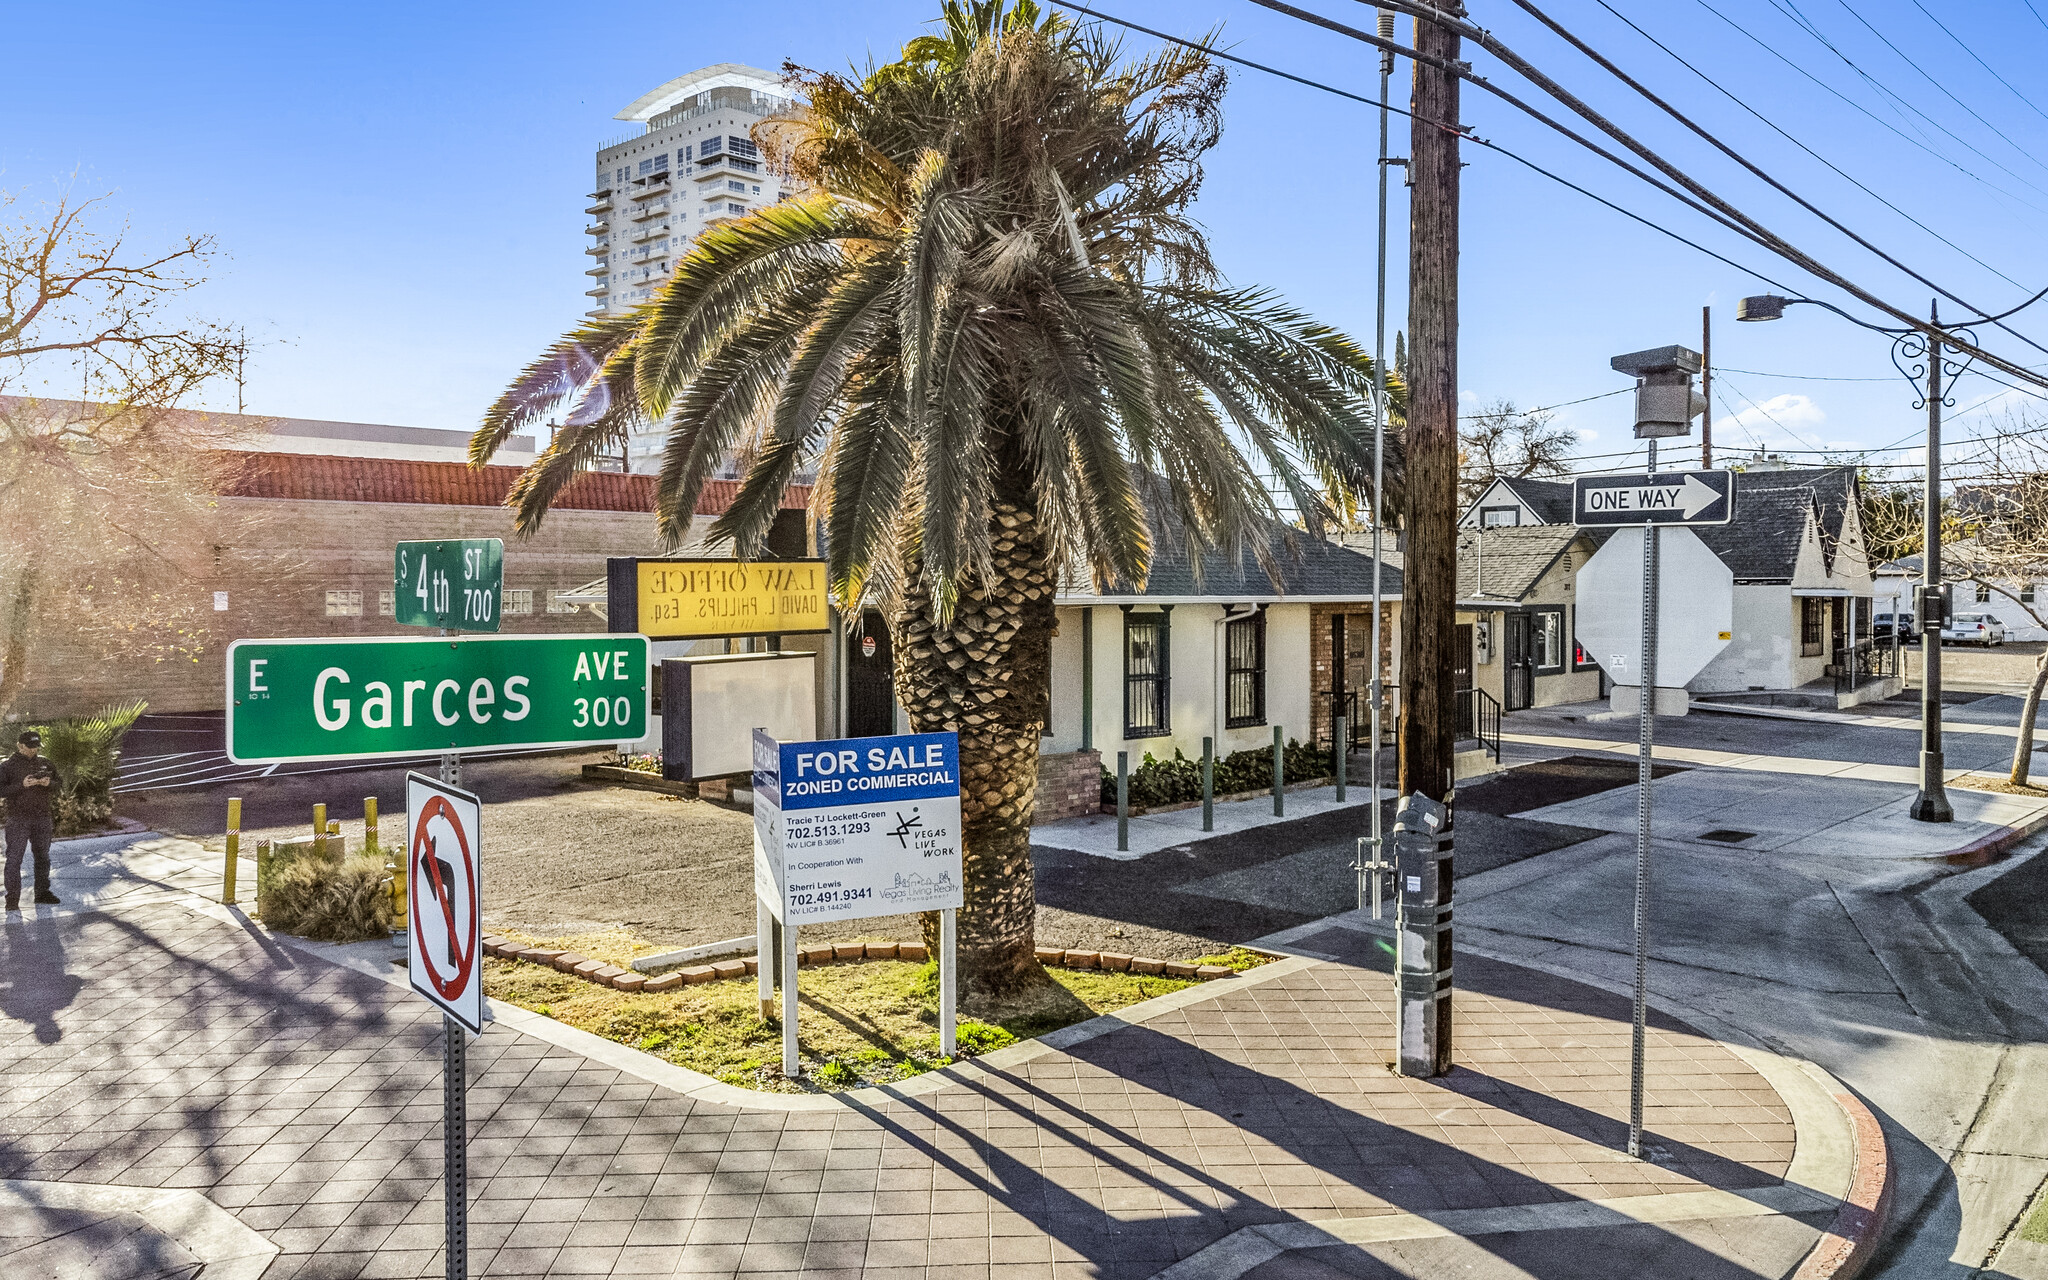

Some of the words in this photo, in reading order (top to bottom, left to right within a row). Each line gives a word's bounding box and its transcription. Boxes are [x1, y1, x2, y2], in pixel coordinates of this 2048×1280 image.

[1591, 491, 1630, 510] ONE
[1638, 488, 1681, 508] WAY
[401, 550, 408, 579] S
[416, 554, 449, 613] 4th
[464, 548, 482, 580] ST
[464, 589, 493, 622] 700
[250, 659, 268, 691] E
[313, 667, 531, 731] Garces
[573, 651, 629, 681] AVE
[573, 696, 631, 727] 300
[797, 750, 859, 777] FOR
[867, 743, 944, 771] SALE
[786, 779, 843, 796] ZONED
[847, 771, 954, 791] COMMERCIAL
[787, 816, 813, 825] Tracie
[814, 815, 825, 823] TJ
[827, 811, 886, 822] Lockett-Green
[787, 822, 871, 840] 702.513.1293
[914, 828, 947, 839] VEGAS
[915, 840, 936, 849] LIVE
[923, 847, 954, 857] WORK
[797, 859, 844, 870] Cooperation
[846, 857, 863, 865] With
[789, 882, 815, 892] Sherri
[817, 880, 842, 889] Lewis
[879, 889, 906, 899] Vegas
[909, 887, 932, 896] Living
[934, 883, 960, 893] Realty
[790, 887, 872, 906] 702.491.9341
